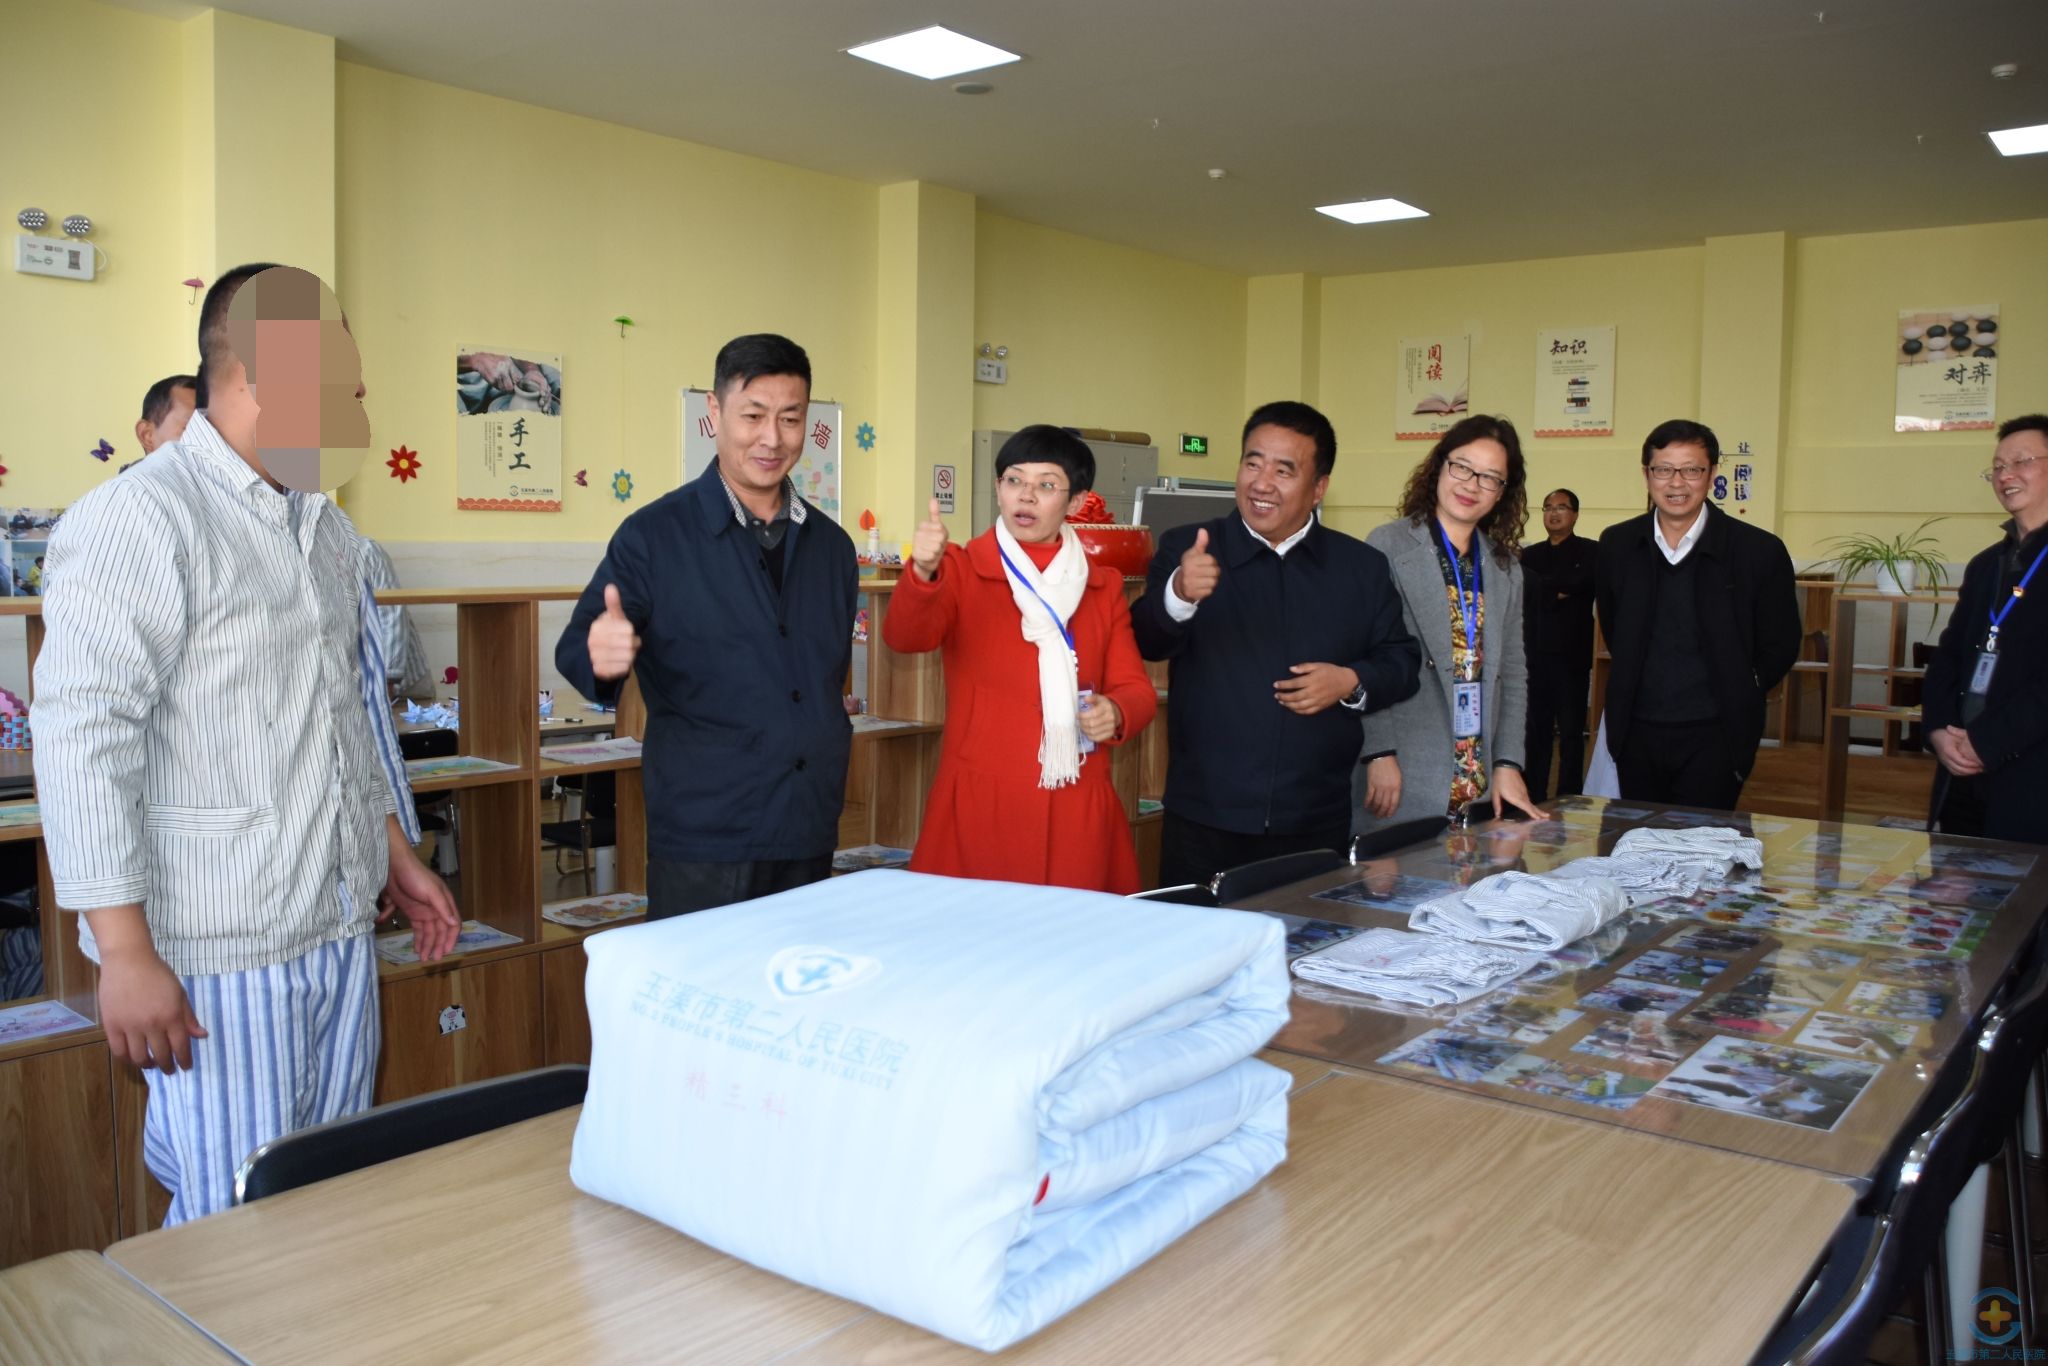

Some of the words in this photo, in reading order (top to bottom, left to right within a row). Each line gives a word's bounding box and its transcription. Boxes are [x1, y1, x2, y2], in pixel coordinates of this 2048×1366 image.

[1426, 344, 1442, 380] 阅读
[1550, 339, 1587, 355] 知识
[1944, 361, 1991, 385] 对弈
[508, 417, 531, 470] 手工
[810, 419, 832, 449] 墙
[1738, 442, 1750, 454] 让
[637, 970, 911, 1073] 玉溪市第二人民医院
